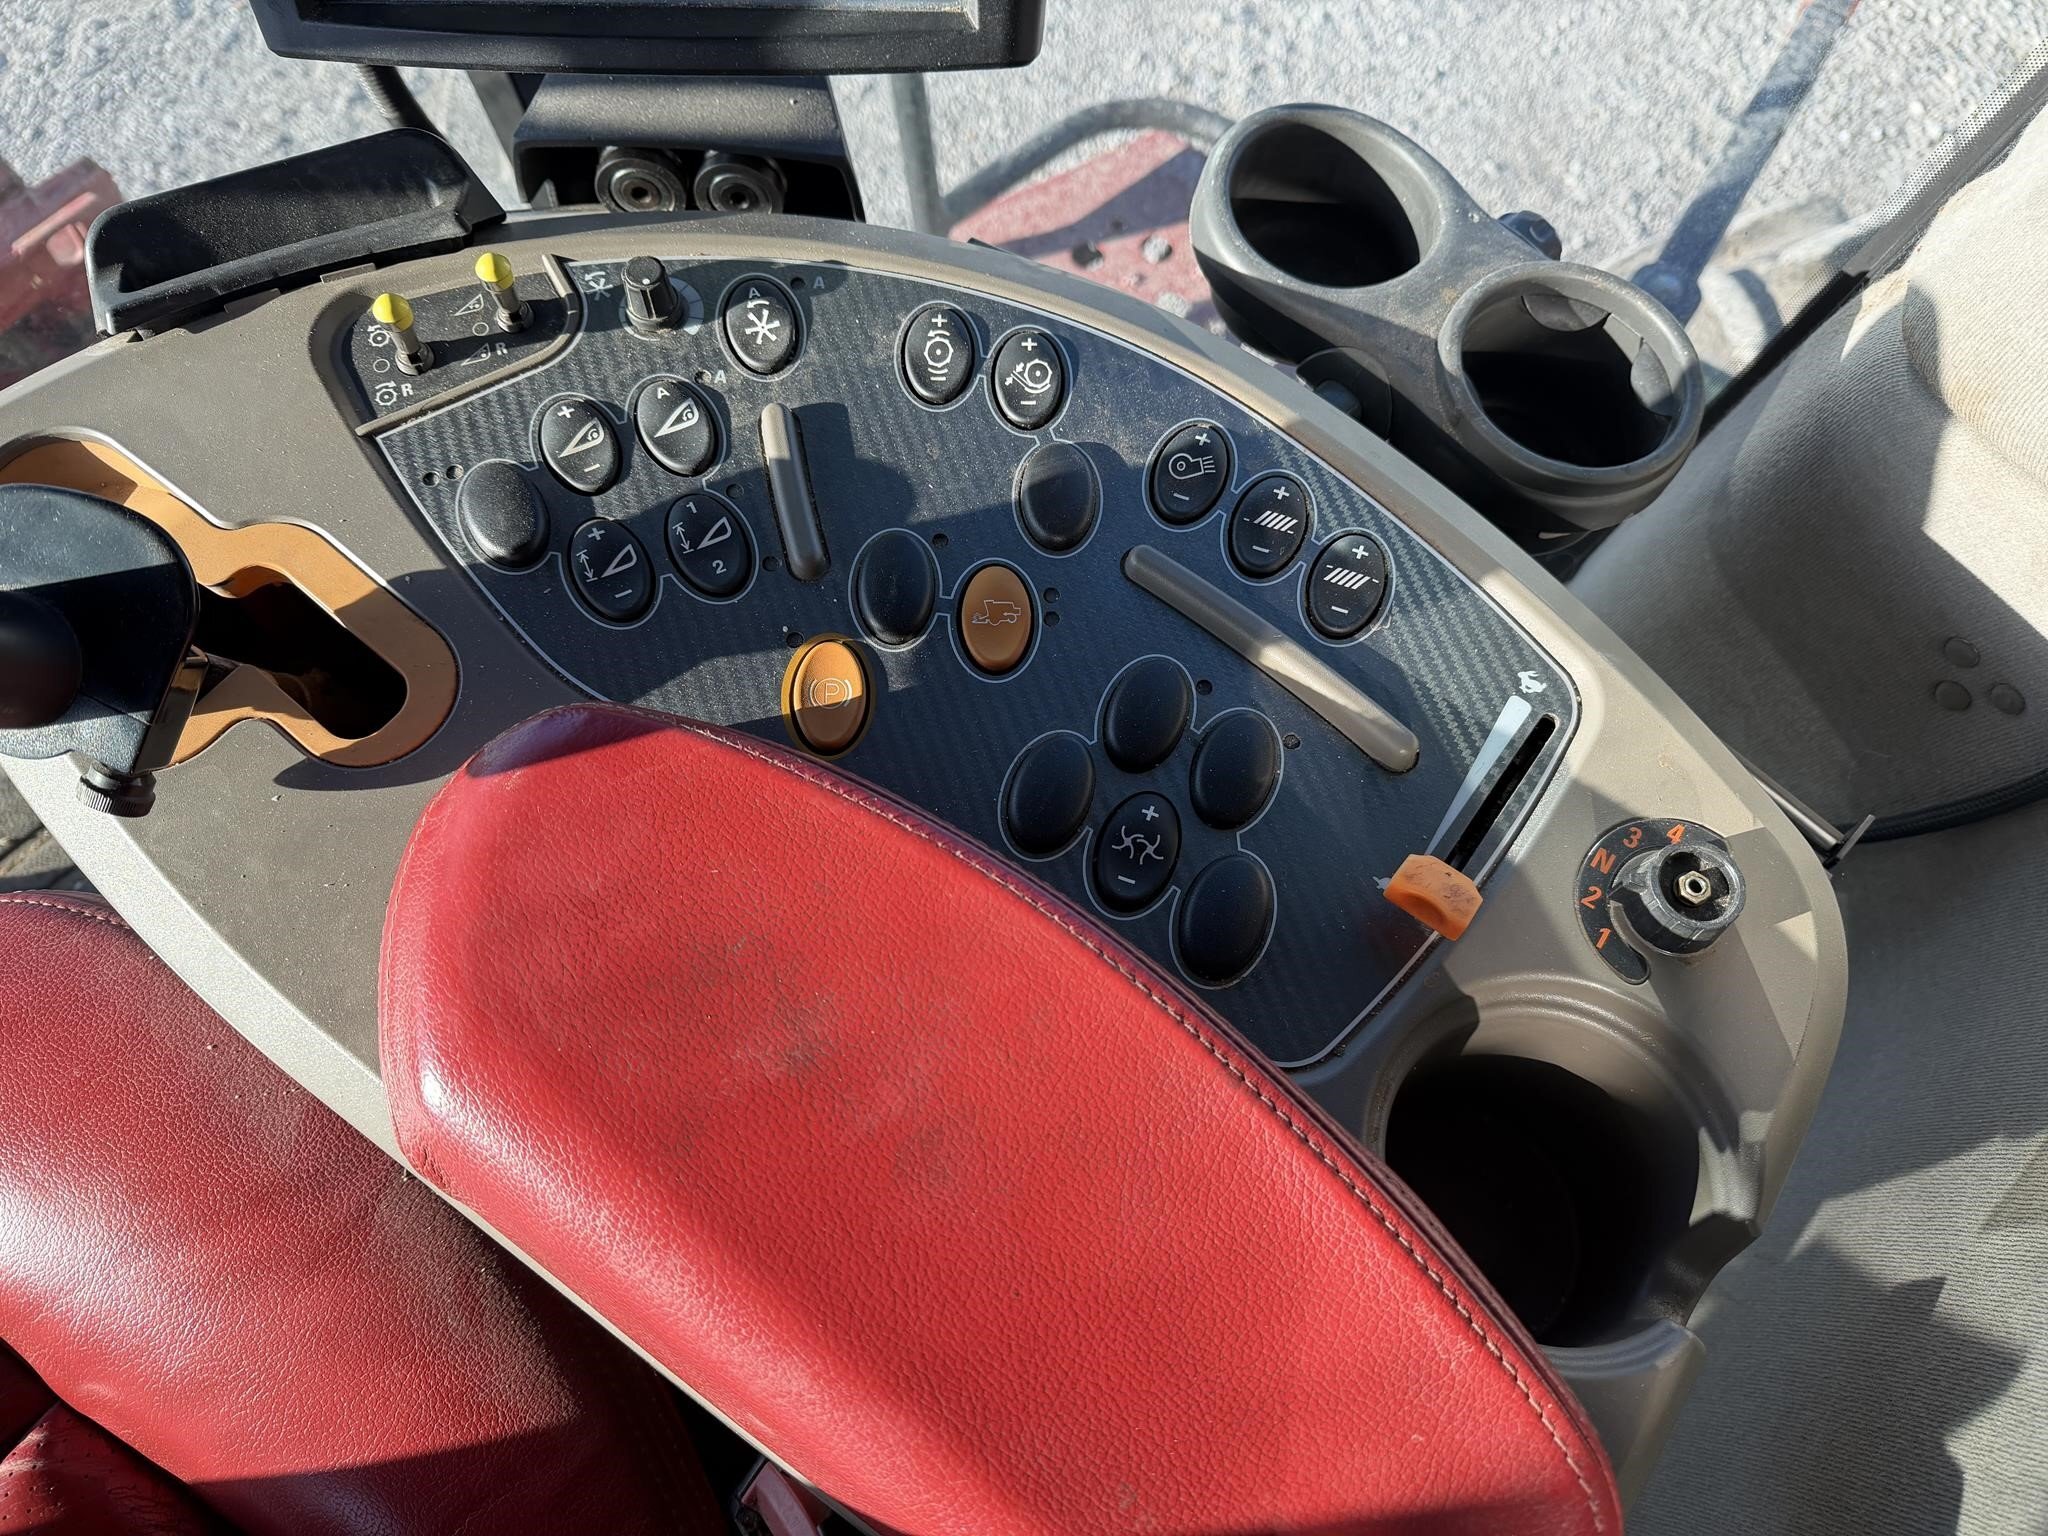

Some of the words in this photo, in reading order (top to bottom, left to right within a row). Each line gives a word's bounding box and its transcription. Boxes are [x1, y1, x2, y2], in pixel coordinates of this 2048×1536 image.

[813, 276, 826, 289] A
[749, 287, 761, 299] A
[496, 343, 509, 356] R
[714, 369, 727, 384] A
[400, 383, 414, 398] R
[656, 387, 670, 400] A
[686, 501, 697, 515] 1
[712, 559, 727, 575] 2
[825, 683, 840, 702] P
[1623, 827, 1643, 849] 3
[1666, 823, 1686, 845] 4
[1590, 847, 1616, 875] N
[1581, 886, 1602, 910] 2
[1596, 927, 1611, 950] 1
